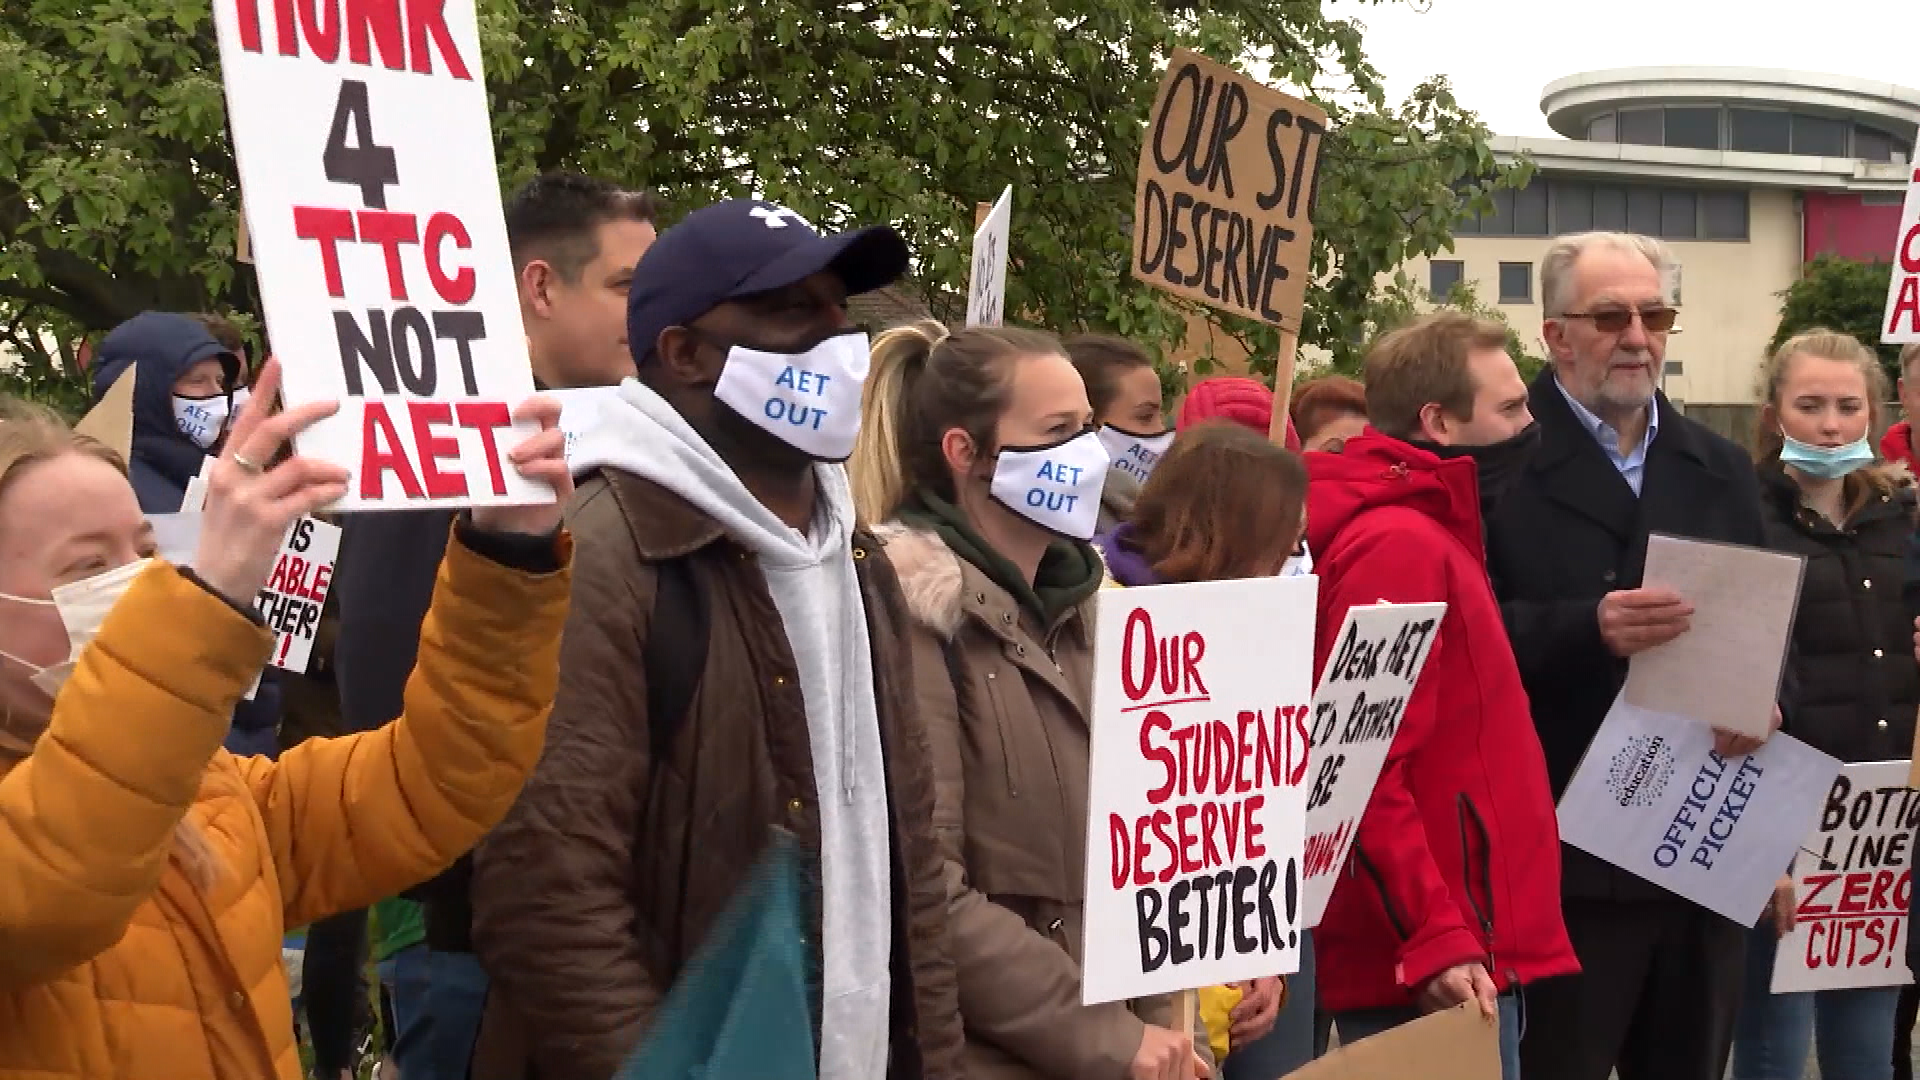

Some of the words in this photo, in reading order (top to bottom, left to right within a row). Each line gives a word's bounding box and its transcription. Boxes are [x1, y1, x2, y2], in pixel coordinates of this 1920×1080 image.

[322, 78, 399, 210] 4
[1153, 63, 1248, 198] OUR
[292, 205, 477, 306] TTC
[1140, 179, 1296, 323] DESERVE
[331, 305, 487, 397] NOT
[775, 365, 831, 397] AET
[183, 404, 212, 422] AET
[359, 401, 512, 500] AET
[764, 397, 828, 431] OUT
[1128, 443, 1160, 465] AET
[1026, 487, 1079, 513] OUT
[1036, 459, 1084, 487] AET
[288, 517, 315, 553] IS
[1121, 606, 1210, 700] OUR
[1139, 705, 1311, 805] STUDENTS
[1306, 753, 1346, 812] BE
[1620, 735, 1664, 807] education
[1109, 795, 1266, 891] DESERVE
[1653, 749, 1728, 869] OFFICIA
[1690, 754, 1764, 871] PICKET
[1796, 869, 1911, 915] ZERO
[1819, 832, 1909, 872] LINE
[1135, 857, 1297, 974] BETTER!
[1805, 917, 1901, 969] CUTS!
